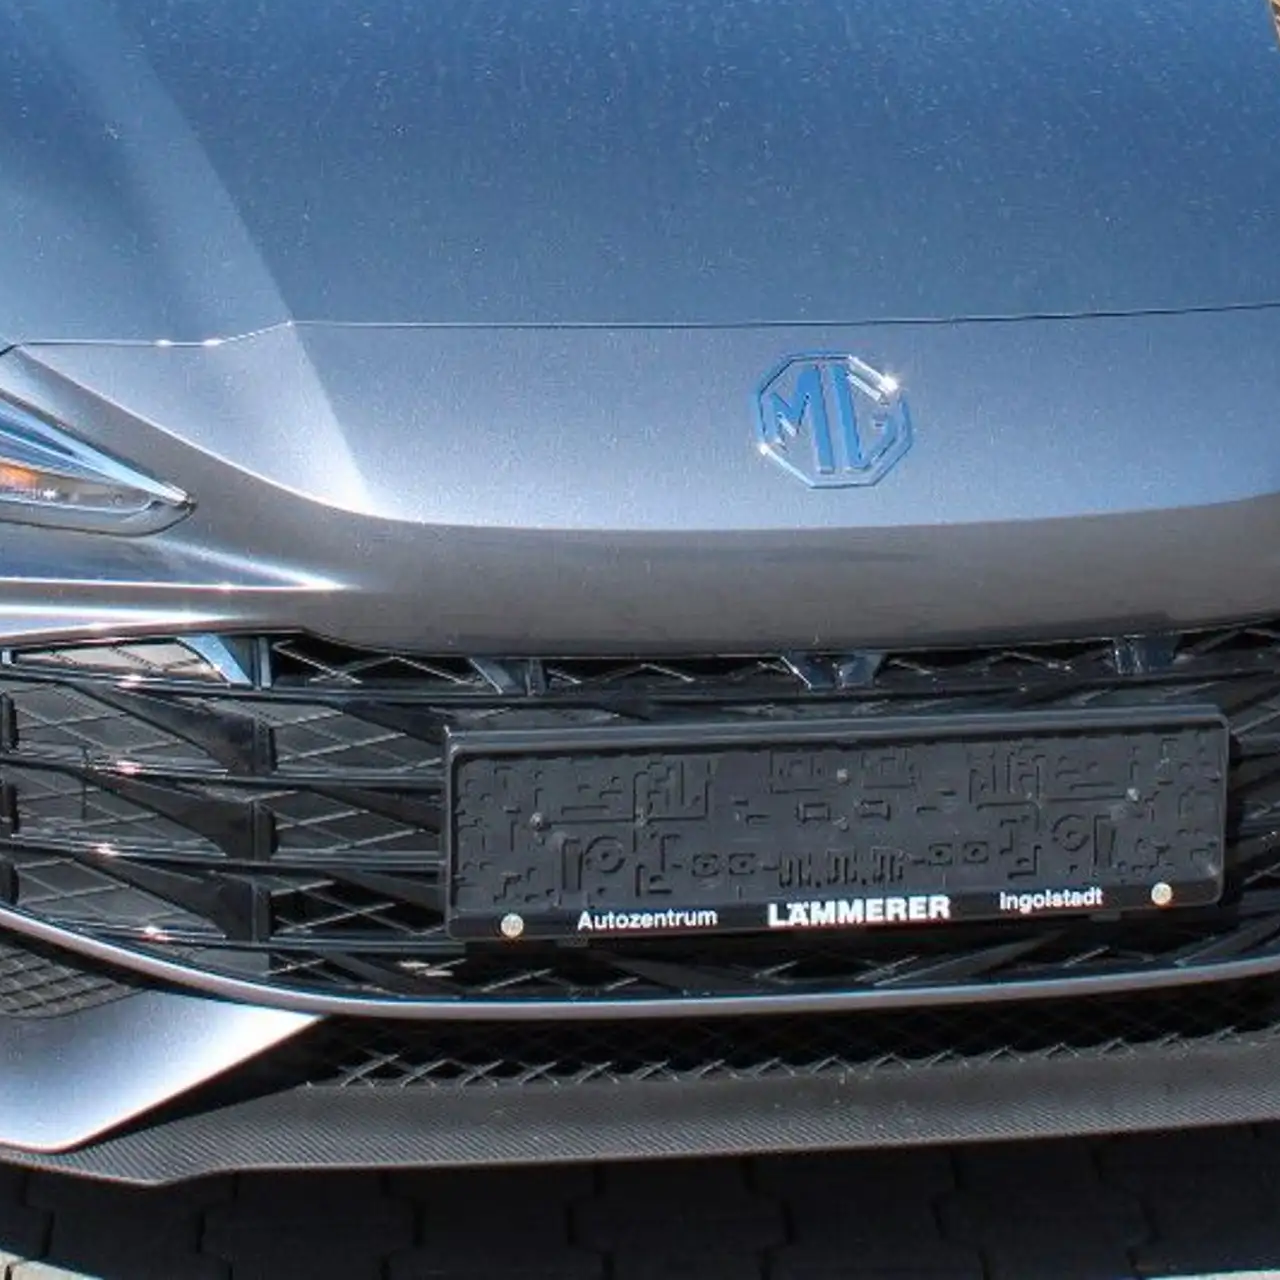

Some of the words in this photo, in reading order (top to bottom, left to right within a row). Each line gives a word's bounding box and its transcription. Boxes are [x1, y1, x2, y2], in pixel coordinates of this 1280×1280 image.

[576, 907, 718, 931] Autozentrum
[767, 894, 951, 927] LÄMMERER
[999, 886, 1104, 913] Ingolstadt
